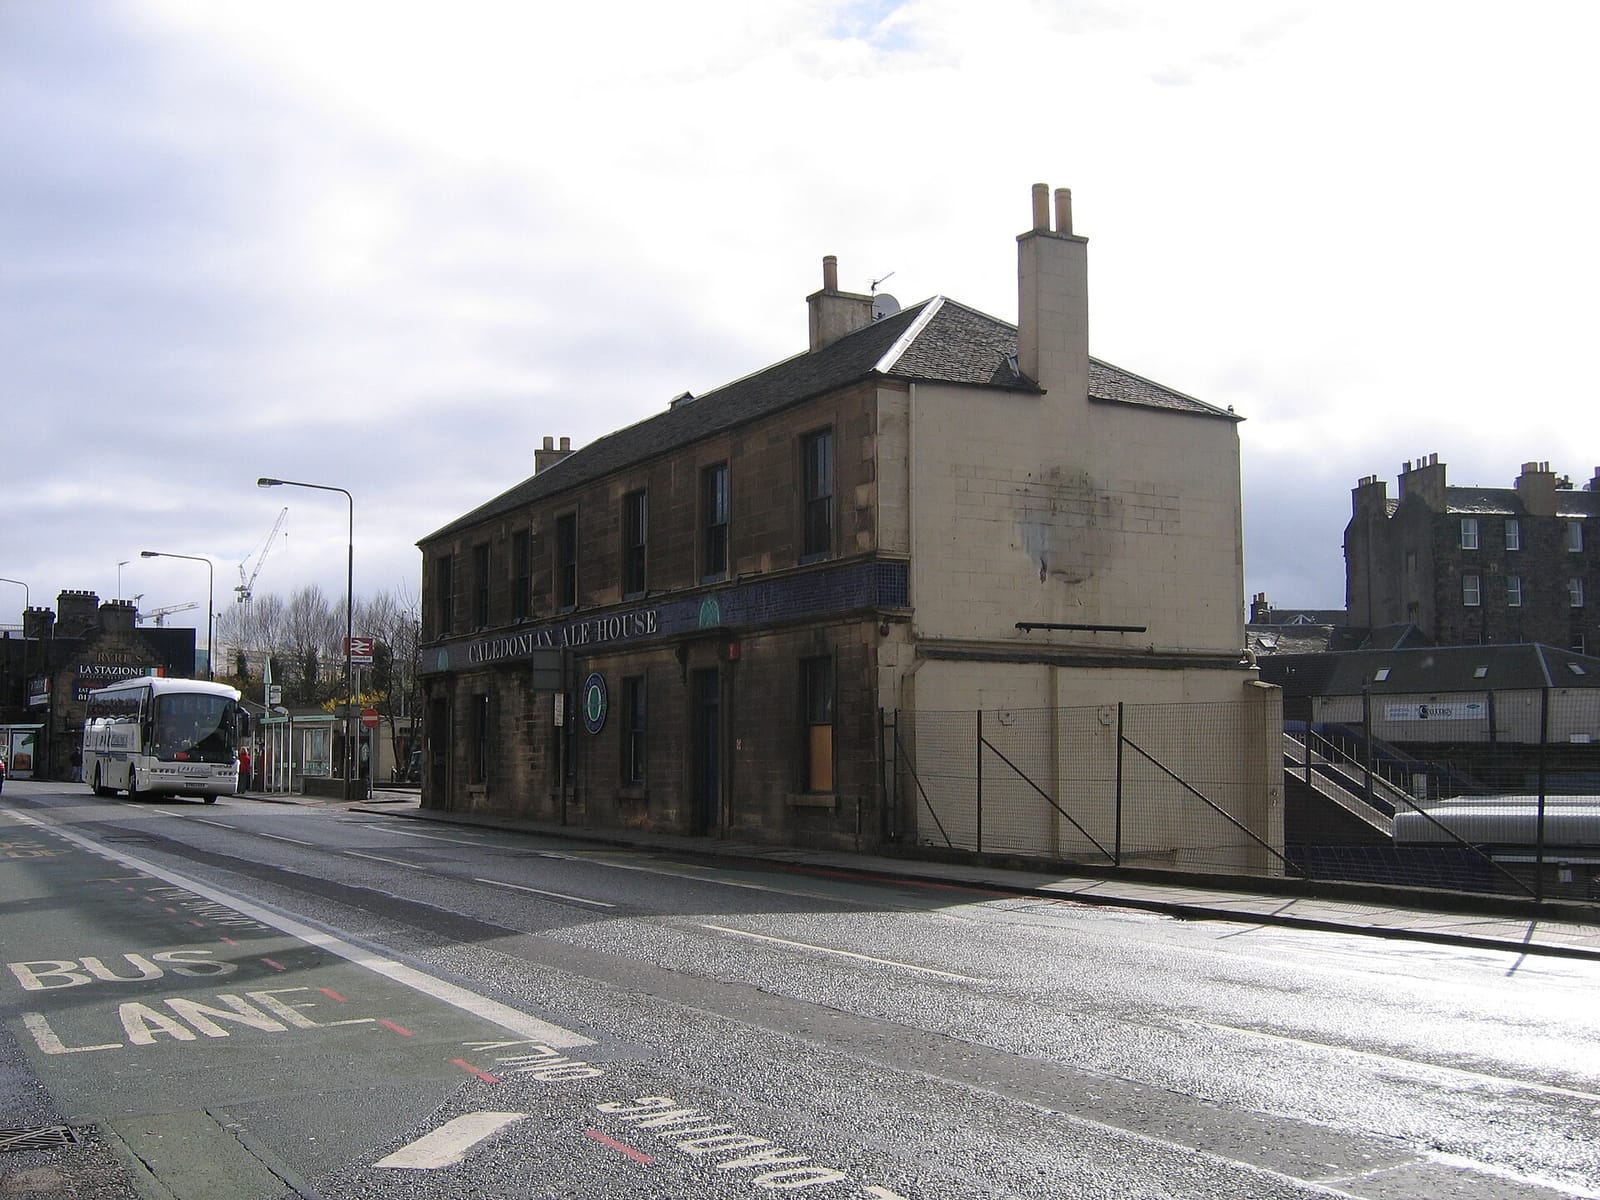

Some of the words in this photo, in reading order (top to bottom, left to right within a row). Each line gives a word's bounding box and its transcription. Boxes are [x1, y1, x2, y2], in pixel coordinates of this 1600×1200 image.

[468, 630, 553, 663] CALEDONIAN
[560, 622, 590, 648] ALE
[597, 610, 657, 642] HOUSE
[79, 665, 92, 674] LA
[94, 665, 144, 676] STAZIONE
[8, 950, 237, 991] BUS
[23, 988, 376, 1055] LANE
[461, 1039, 603, 1081] ONLY
